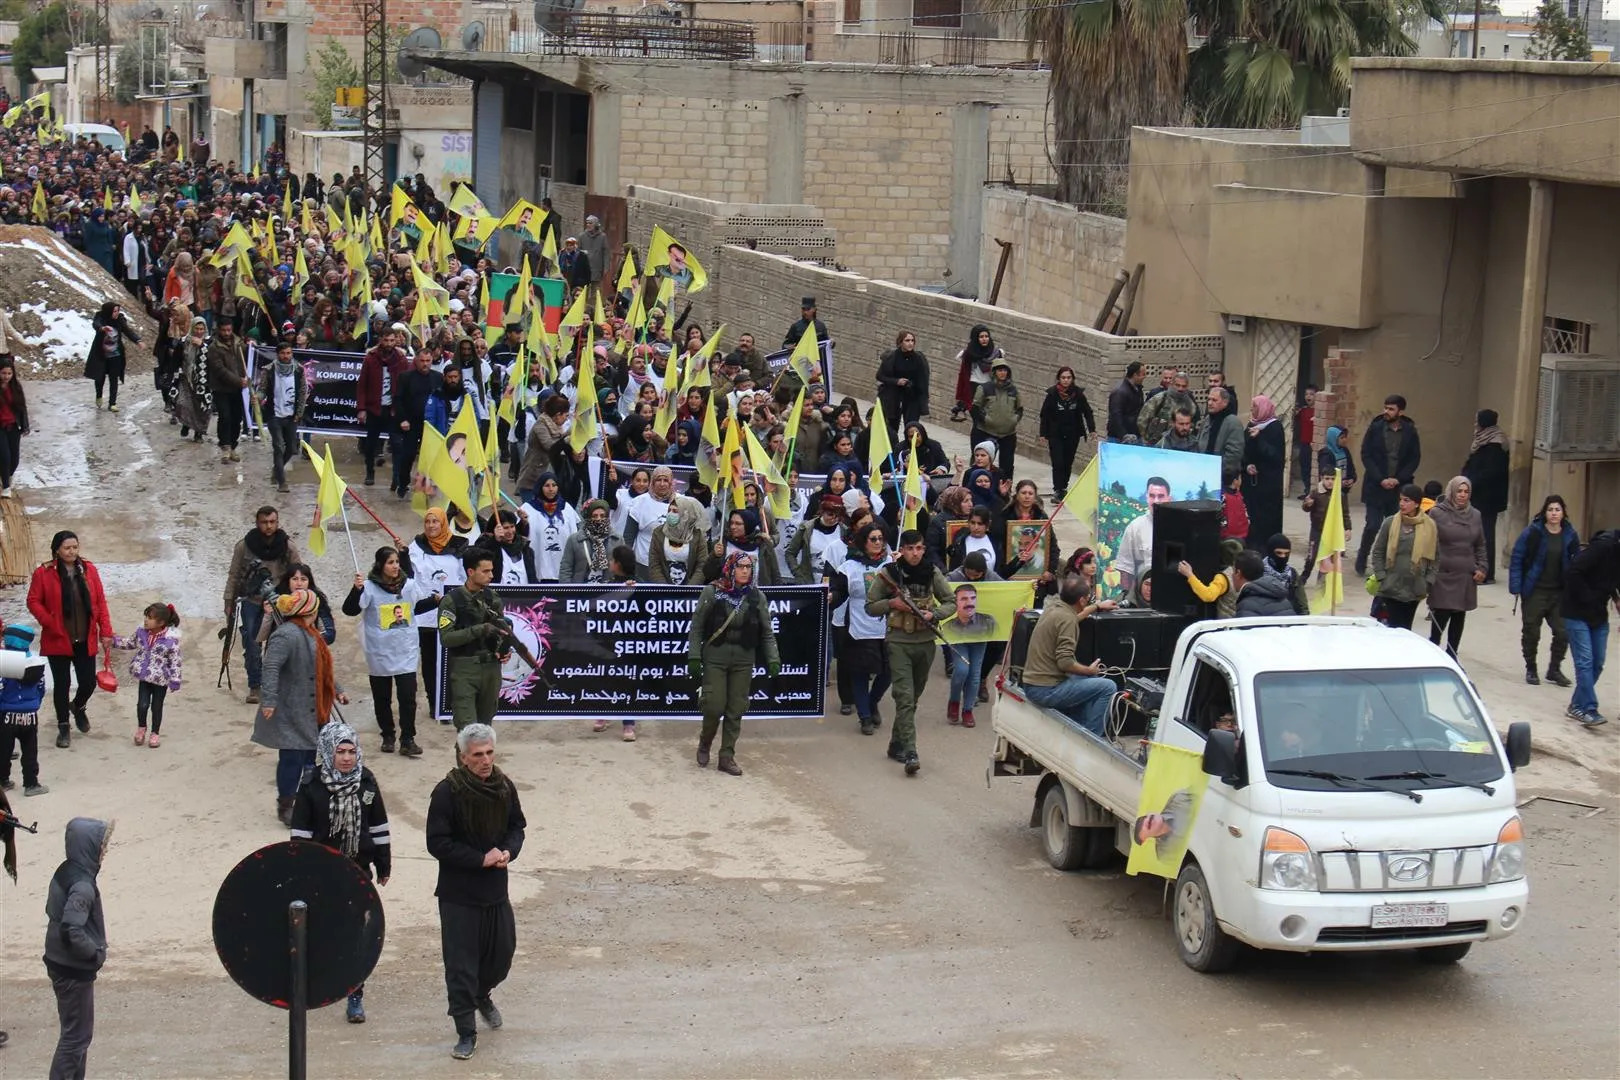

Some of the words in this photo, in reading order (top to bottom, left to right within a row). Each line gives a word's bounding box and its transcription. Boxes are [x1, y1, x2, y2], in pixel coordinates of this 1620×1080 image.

[441, 135, 472, 152] SIST
[340, 361, 354, 370] EM
[316, 371, 361, 381] KOMPLOY
[566, 600, 590, 613] EM
[596, 600, 639, 613] ROJA
[614, 641, 690, 658] ŞERMEZA
[553, 662, 605, 679] الشعوب
[608, 664, 637, 680] إبادة
[640, 665, 663, 680] يوم
